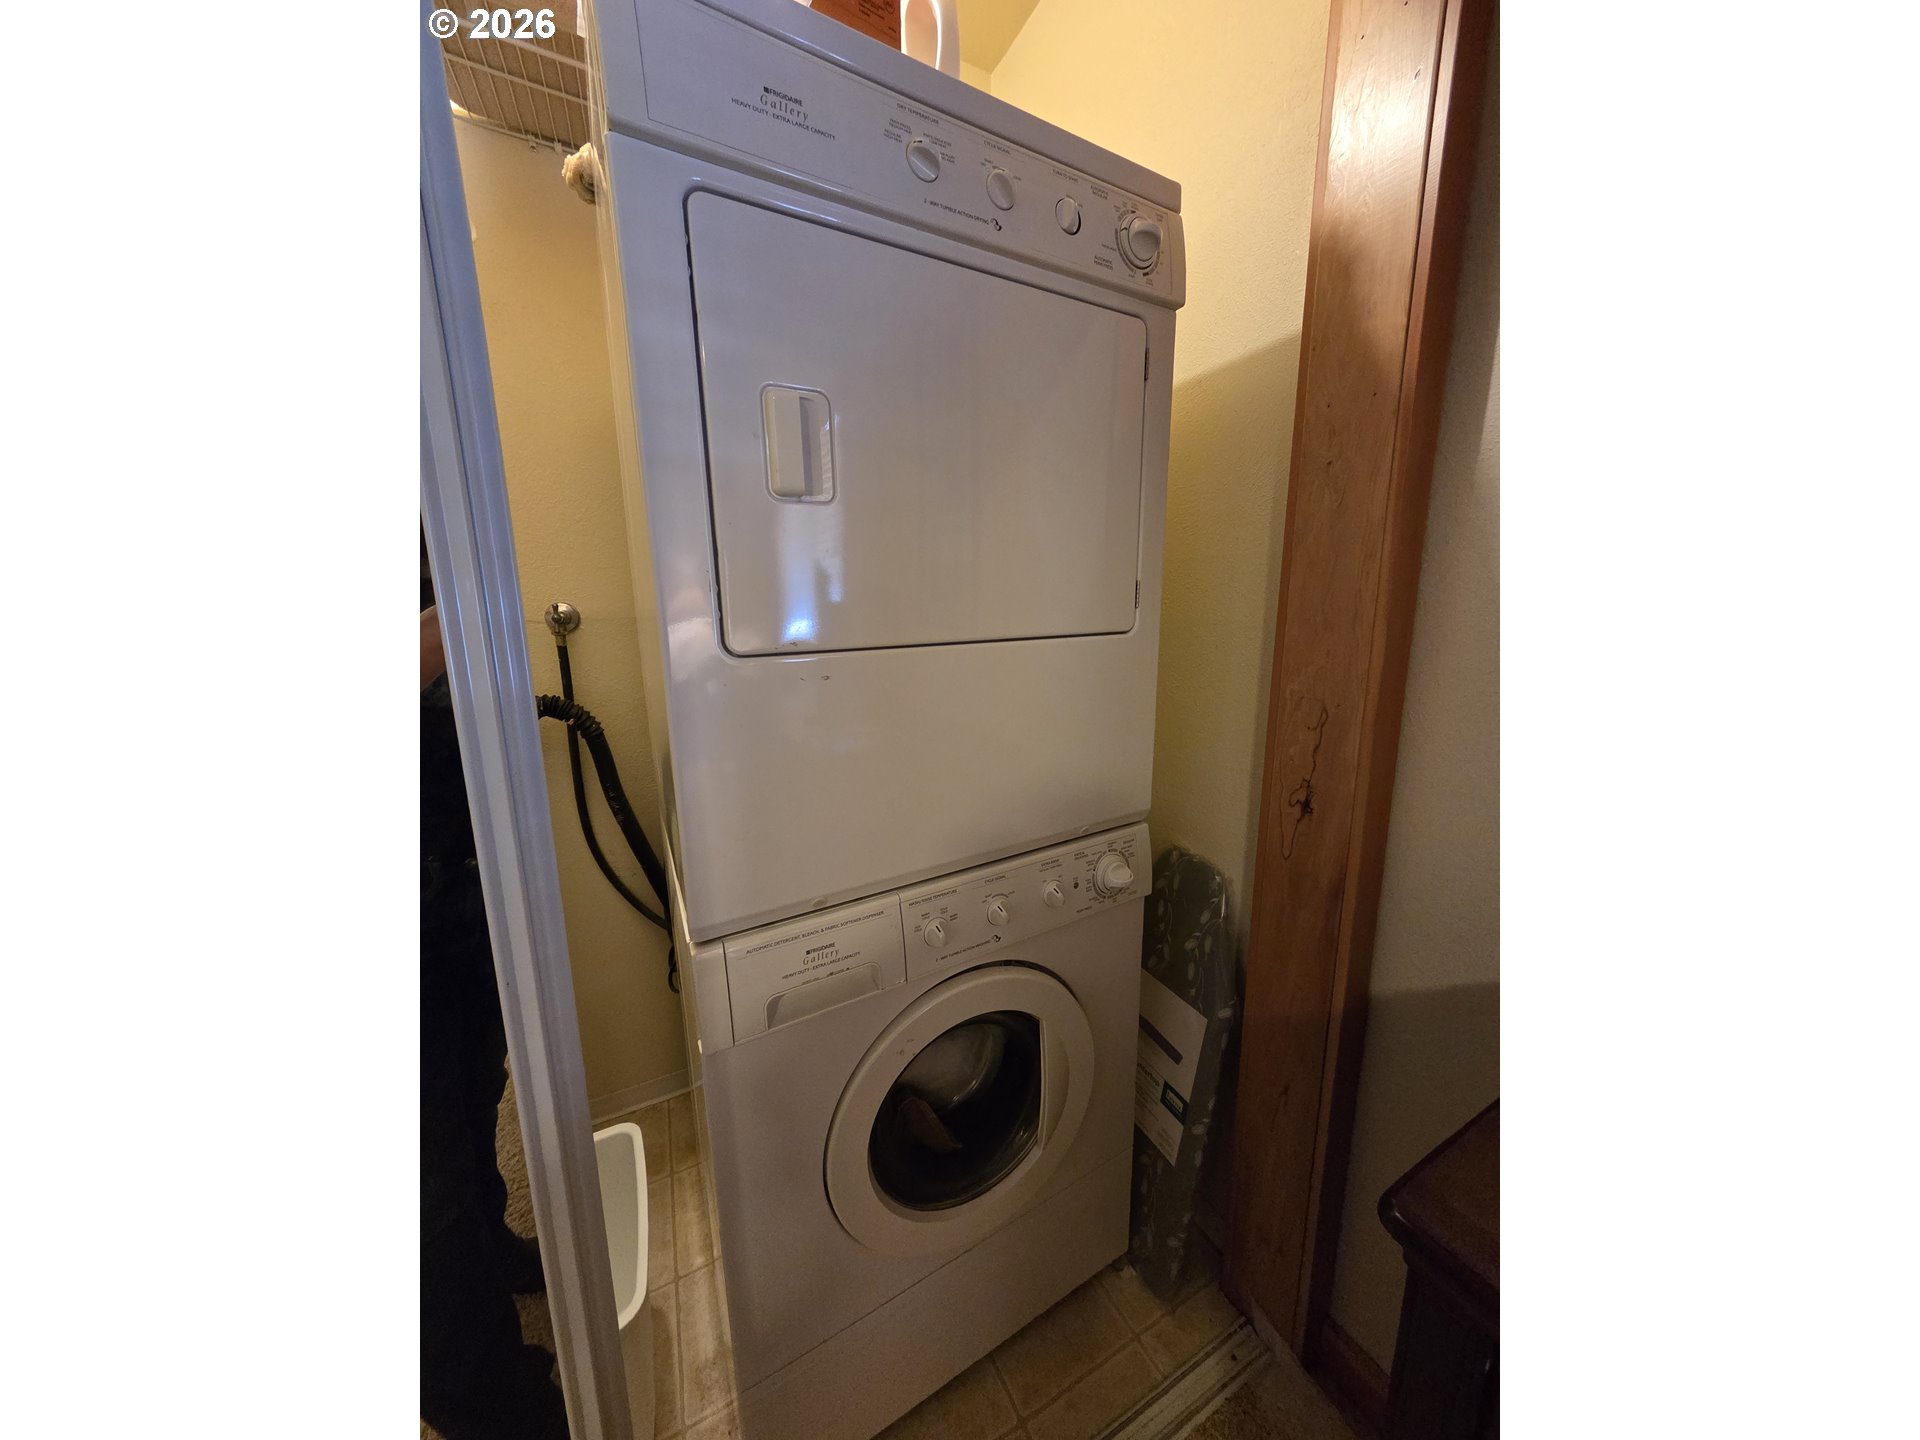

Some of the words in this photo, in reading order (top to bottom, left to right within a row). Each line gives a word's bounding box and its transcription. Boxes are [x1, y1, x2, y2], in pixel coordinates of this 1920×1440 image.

[760, 94, 809, 122] Gallery
[769, 88, 804, 107] FRIGIDAIRE
[731, 97, 752, 110] HEAVY
[752, 105, 769, 116] DUTY
[772, 111, 791, 125] EXTRA
[791, 120, 810, 132] LARGE
[810, 126, 836, 141] CAPACITY
[745, 943, 773, 955] AUTOMATIC
[824, 924, 841, 932] FABRIC
[840, 917, 862, 928] SOFTENER
[862, 910, 885, 921] DISPENSER
[802, 949, 839, 966] Gallery
[810, 942, 836, 954] FRIGIDAIRE
[781, 971, 797, 980] HEAVY
[812, 962, 826, 970] EXTRA
[826, 957, 841, 966] LARGE
[841, 951, 860, 961] CAPACITY
